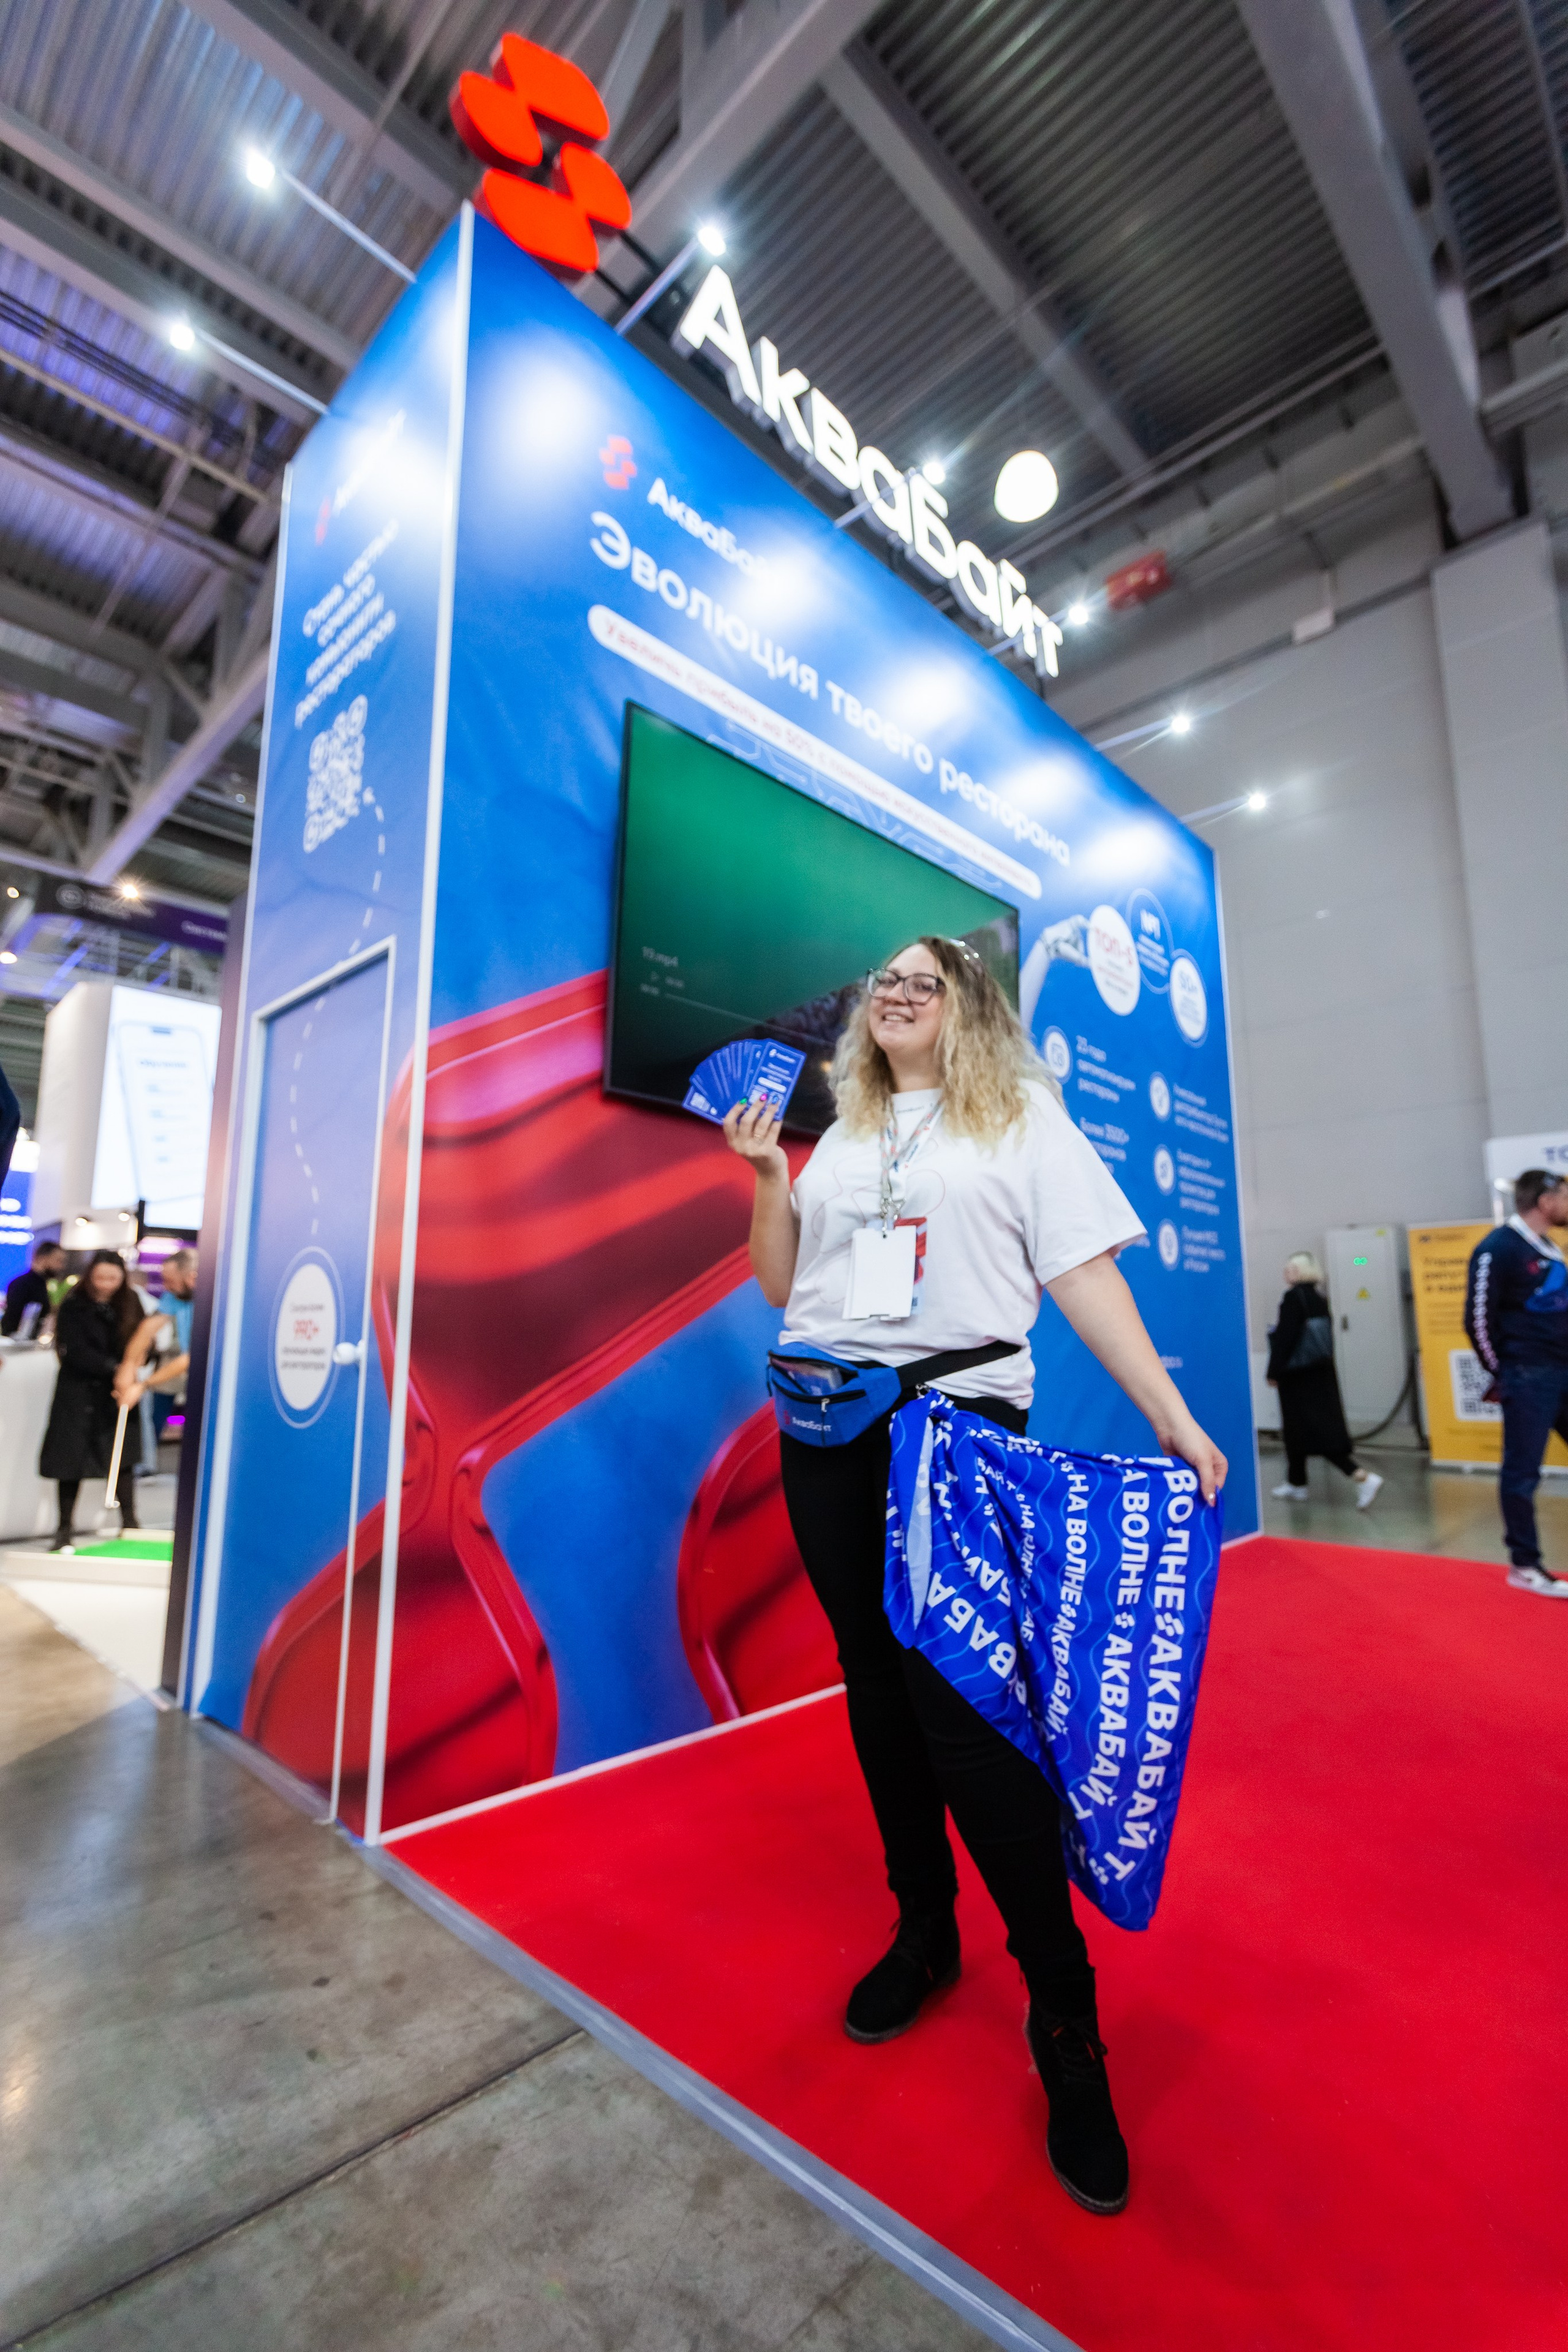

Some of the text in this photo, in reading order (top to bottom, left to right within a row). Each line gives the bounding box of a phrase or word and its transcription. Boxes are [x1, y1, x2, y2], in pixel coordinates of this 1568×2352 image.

[589, 511, 819, 699] Эволюция
[826, 680, 934, 775] твоего
[939, 758, 1071, 867] ресторана
[1060, 1517, 1087, 1606] ВОЛНЕ
[1066, 1474, 1089, 1512] НА
[1117, 1490, 1150, 1607] ВОЛНЕ
[1153, 1469, 1198, 1611] ВОЛНЕ
[1068, 1632, 1134, 1820] АКВАБАЙТ
[1103, 1634, 1183, 1882] АКВАБАЙТ
